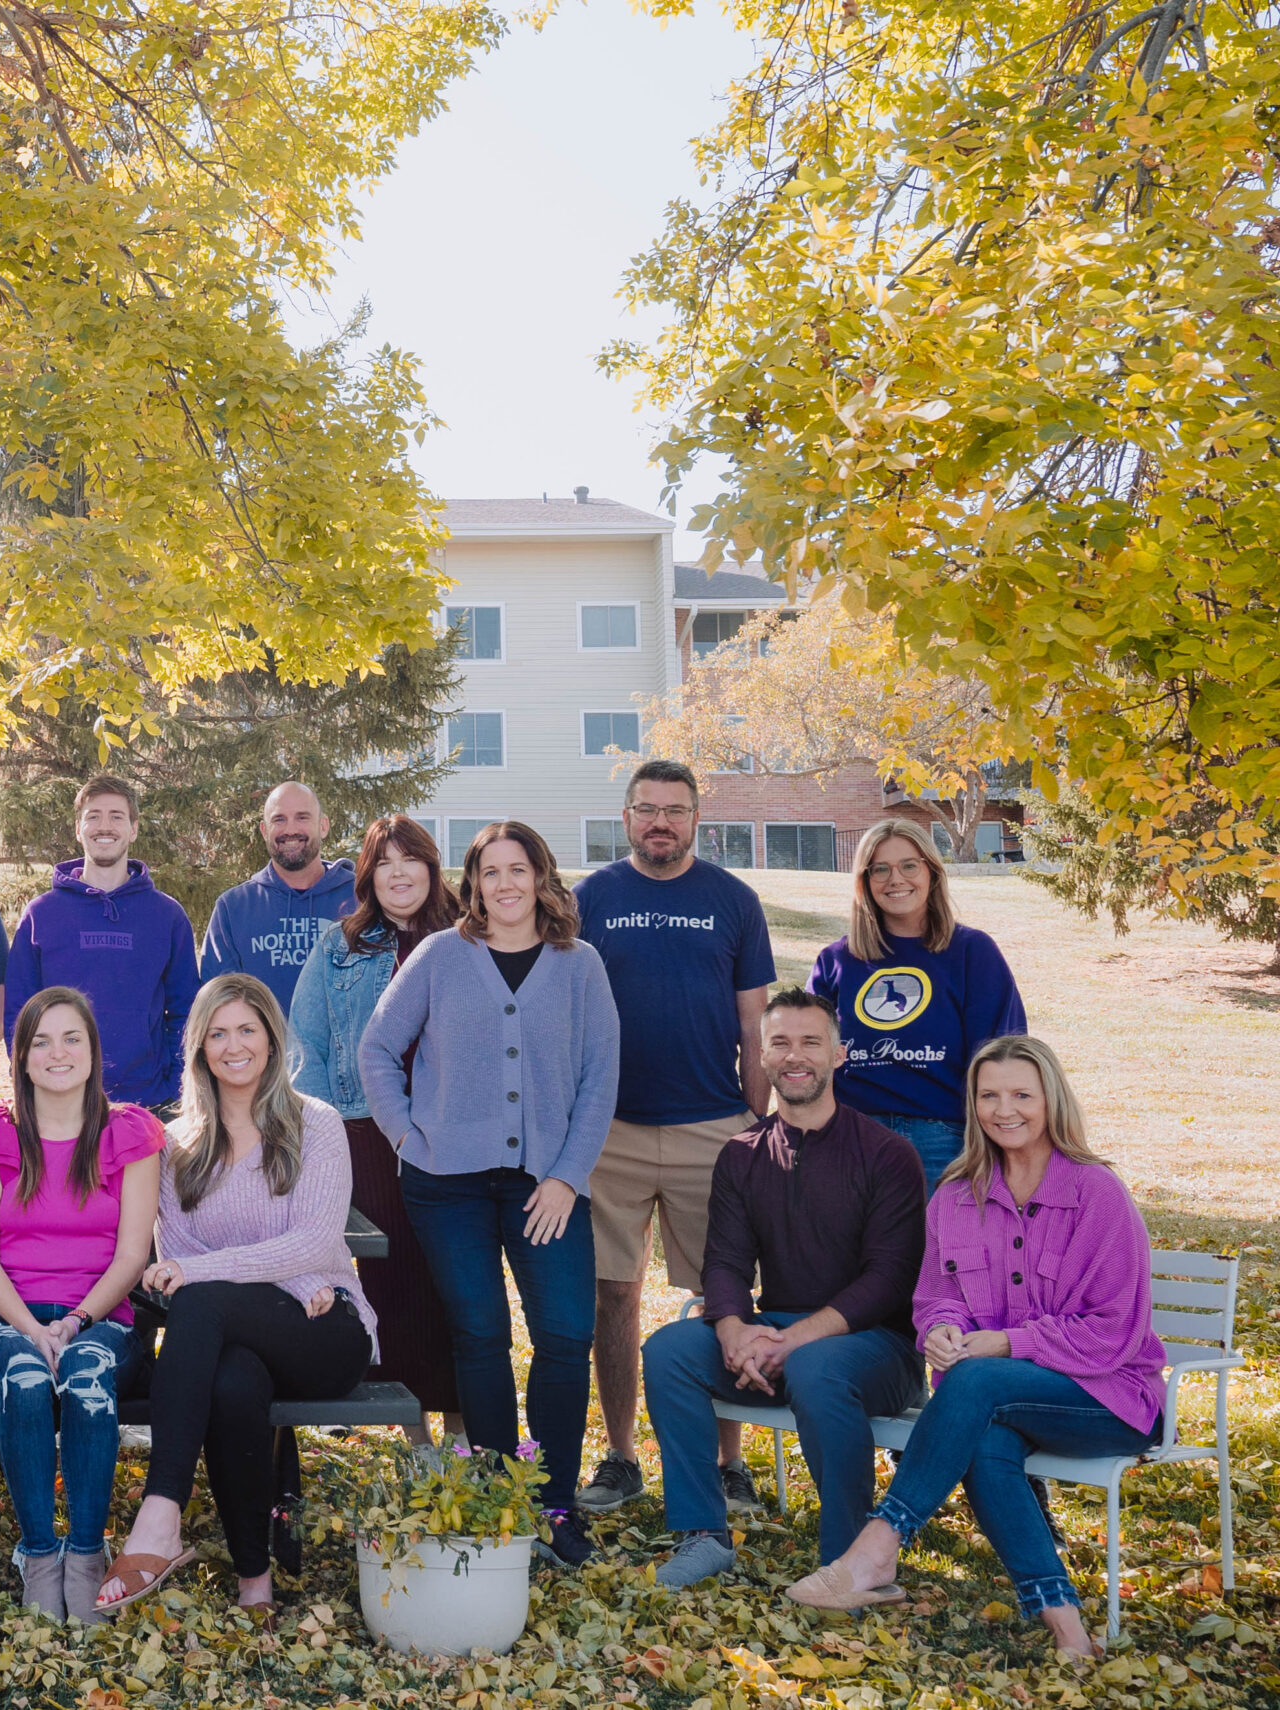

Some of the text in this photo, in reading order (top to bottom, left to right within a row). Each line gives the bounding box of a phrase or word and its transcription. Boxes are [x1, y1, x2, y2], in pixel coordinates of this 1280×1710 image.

[279, 917, 318, 932] THE
[83, 935, 129, 946] VIKINGS
[270, 948, 309, 967] FAC
[870, 1037, 945, 1061] Poochs
